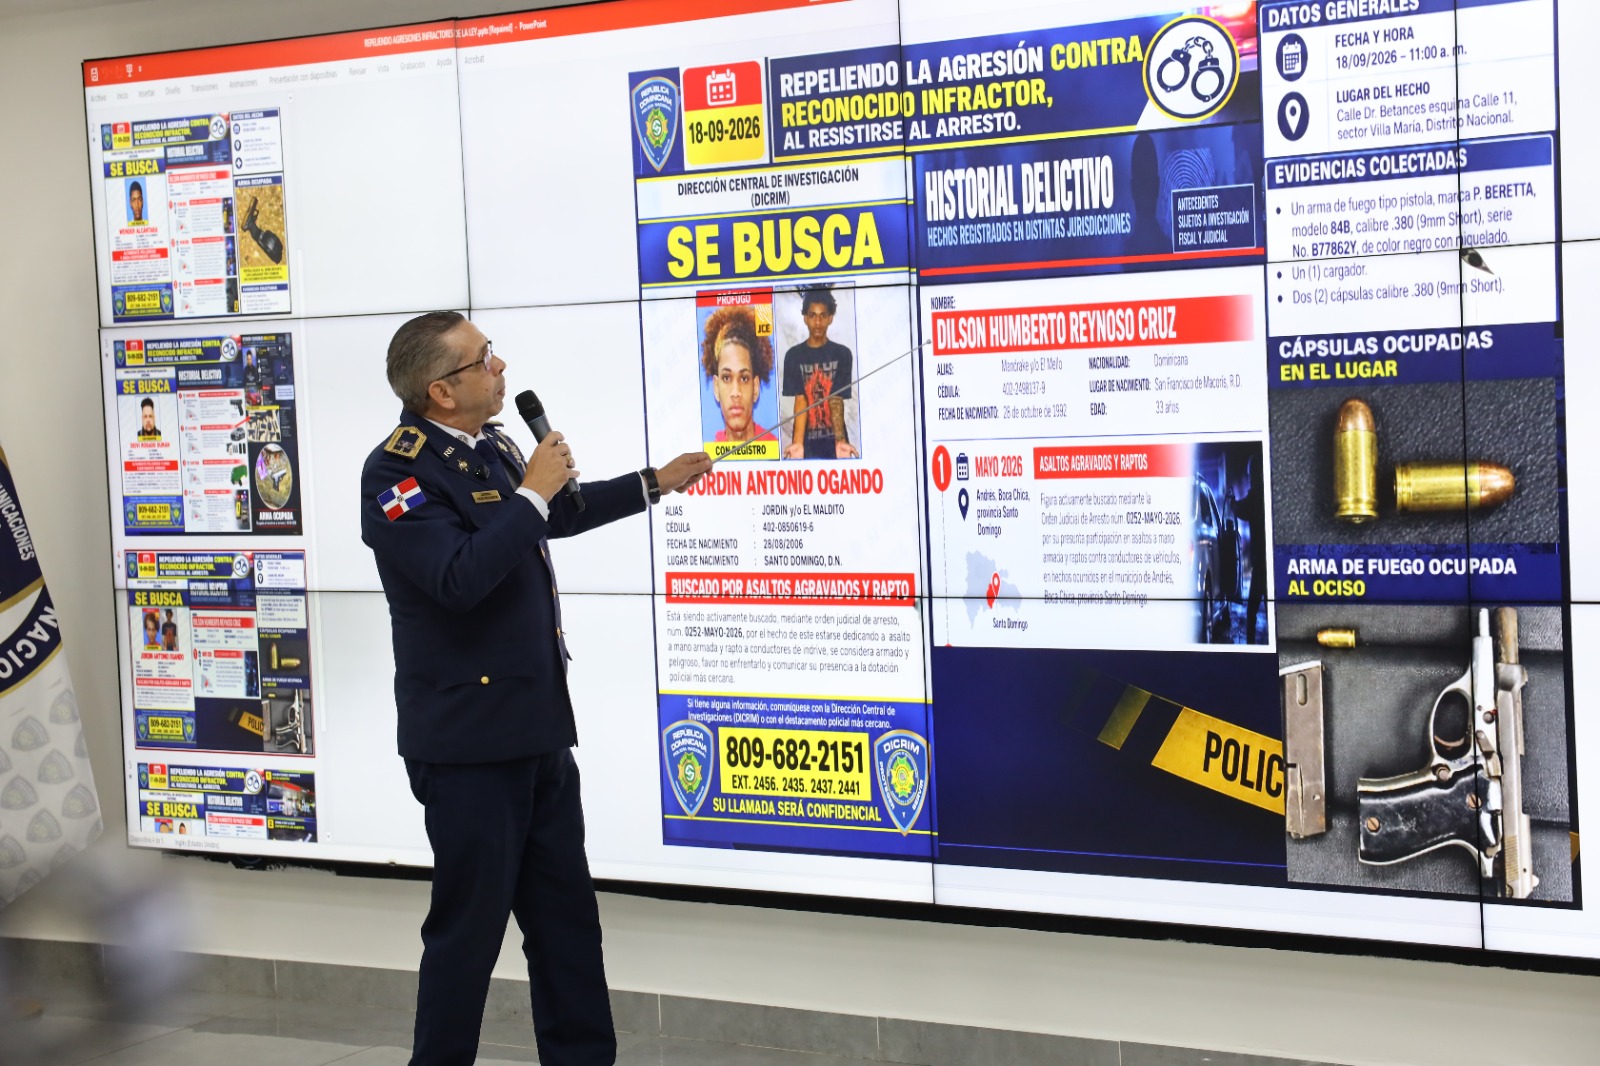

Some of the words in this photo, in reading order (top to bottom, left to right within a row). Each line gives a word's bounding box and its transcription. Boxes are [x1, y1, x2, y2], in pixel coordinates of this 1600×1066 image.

[519, 20, 546, 30] PowerPoint
[1268, 3, 1321, 28] DATOS
[1325, 0, 1420, 22] GENERALES
[1335, 31, 1370, 48] FECHA
[1372, 31, 1380, 44] Y
[1382, 26, 1414, 43] HORA
[780, 60, 900, 98] REPELIENDO
[906, 58, 932, 86] LA
[938, 40, 1044, 83] AGRESIÓN
[1050, 34, 1144, 72] CONTRA
[1335, 53, 1397, 70] 18/09/2026
[1409, 46, 1438, 61] 11:00
[782, 91, 915, 128] RECONOCIDO
[922, 78, 1054, 116] INFRACTOR,
[1335, 88, 1370, 104] LUGAR
[1373, 86, 1392, 100] DEL
[1395, 82, 1430, 97] HECHO
[1336, 106, 1362, 122] Calle
[1364, 105, 1377, 120] Dr.
[1379, 102, 1426, 119] Betances
[1428, 97, 1470, 117] esquina
[1472, 94, 1499, 109] Calle
[1502, 91, 1518, 106] 11,
[688, 115, 761, 144] 18-09-2026
[783, 130, 804, 150] AL
[808, 120, 903, 148] RESISTIRSE
[909, 118, 932, 140] AL
[936, 111, 1022, 138] ARRESTO.
[1336, 126, 1367, 141] sector
[1370, 122, 1391, 138] Villa
[1393, 119, 1424, 137] María,
[1426, 116, 1465, 132] Distrito
[1466, 110, 1514, 127] Nacional.
[110, 163, 124, 177] SE
[126, 160, 160, 176] BUSCA
[1274, 158, 1366, 185] EVIDENCIAS
[1369, 148, 1468, 177] COLECTADAS
[677, 176, 727, 196] DIRECCIÓN
[728, 175, 768, 192] CENTRAL
[770, 174, 782, 188] DE
[784, 166, 859, 188] INVESTIGACIÓN
[925, 164, 1018, 222] HISTORIAL
[1021, 155, 1114, 217] DELICTIVO
[1473, 186, 1482, 201] P.
[1484, 182, 1536, 201] BERETTA,
[750, 190, 790, 208] (DICRIM)
[1178, 195, 1218, 211] ANTECEDENTES
[927, 225, 958, 248] HECHOS
[959, 222, 1012, 246] REGISTRADOS
[1014, 221, 1024, 242] EN
[1026, 218, 1065, 241] DISTINTAS
[1066, 212, 1131, 238] JURISDICCIONES
[1291, 222, 1328, 239] modelo
[1330, 220, 1354, 236] 84B,
[1355, 218, 1389, 235] calibre
[1392, 216, 1414, 231] .380
[1416, 214, 1445, 231] (9mm
[1448, 210, 1485, 229] Short),
[1487, 208, 1512, 223] serie
[666, 223, 721, 279] SE
[732, 211, 884, 275] BUSCA
[1292, 244, 1310, 259] No.
[1311, 240, 1360, 258] B77862Y,
[1362, 238, 1374, 253] de
[1376, 236, 1400, 252] color
[1402, 236, 1432, 255] negro
[1434, 236, 1454, 249] con
[1292, 266, 1306, 281] Un
[1308, 264, 1320, 283] (1)
[1323, 263, 1367, 282] cargador.
[1292, 289, 1312, 305] Dos
[1314, 288, 1328, 306] (2)
[1330, 286, 1374, 306] cápsulas
[1376, 283, 1408, 300] calibre
[1411, 282, 1434, 298] .380
[1436, 279, 1468, 297] (9mm
[1470, 276, 1504, 294] Short).
[930, 296, 956, 310] NOMBRE:
[758, 324, 770, 334] JCE
[936, 316, 987, 351] DILSON
[990, 310, 1067, 349] HUMBERTO
[1070, 307, 1136, 345] REYNOSO
[1138, 306, 1178, 340] CRUZ
[1278, 335, 1378, 360] CÁPSULAS
[1382, 330, 1494, 355] OCUPADAS
[1089, 356, 1132, 370] NACIONALIDAD:
[1280, 364, 1305, 382] EN
[1309, 363, 1331, 380] EL
[1335, 359, 1398, 380] LUGAR
[122, 380, 137, 394] SE
[138, 379, 171, 394] BUSCA
[1090, 402, 1108, 416] EDAD:
[715, 445, 730, 456] CON
[1040, 454, 1070, 472] ASALTOS
[1071, 453, 1114, 471] AGRAVADOS
[1121, 452, 1149, 470] RAPTOS
[938, 447, 946, 484] 1
[976, 456, 999, 478] MAYO
[1001, 455, 1024, 477] 2026
[746, 469, 814, 496] ANTONIO
[818, 468, 884, 495] OGANDO
[762, 504, 789, 516] JORDIN
[804, 504, 812, 515] EL
[814, 504, 845, 515] MALDITO
[762, 520, 814, 533] 402-0850619-6
[764, 538, 804, 550] 28/08/2006
[1286, 558, 1338, 576] ARMA
[1341, 558, 1365, 575] DE
[1367, 558, 1424, 576] FUEGO
[1428, 558, 1517, 576] OCUPADA
[134, 592, 149, 605] SE
[150, 592, 184, 606] BUSCA
[671, 578, 722, 599] BUSCADO
[722, 578, 746, 599] POR
[746, 578, 792, 600] ASALTOS
[793, 579, 861, 601] AGRAVADOS
[862, 580, 870, 600] Y
[872, 580, 910, 602] RAPTO
[1286, 580, 1309, 596] AL
[1312, 580, 1366, 597] OCISO
[685, 628, 745, 640] 0252-MAYO-2026,
[726, 735, 865, 774] 809-682-2151
[883, 738, 920, 756] DICRIM
[1202, 730, 1284, 798] POLIC
[732, 774, 752, 790] EXT.
[753, 775, 779, 792] 2456.
[782, 776, 808, 793] 2435.
[810, 778, 836, 795] 2437.
[838, 780, 860, 796] 2441
[146, 802, 160, 816] SE
[162, 802, 198, 818] BUSCA
[712, 796, 727, 813] SU
[729, 797, 776, 818] LLAMADA
[778, 798, 805, 818] SERÁ
[806, 801, 882, 822] CONFIDENCIAL
